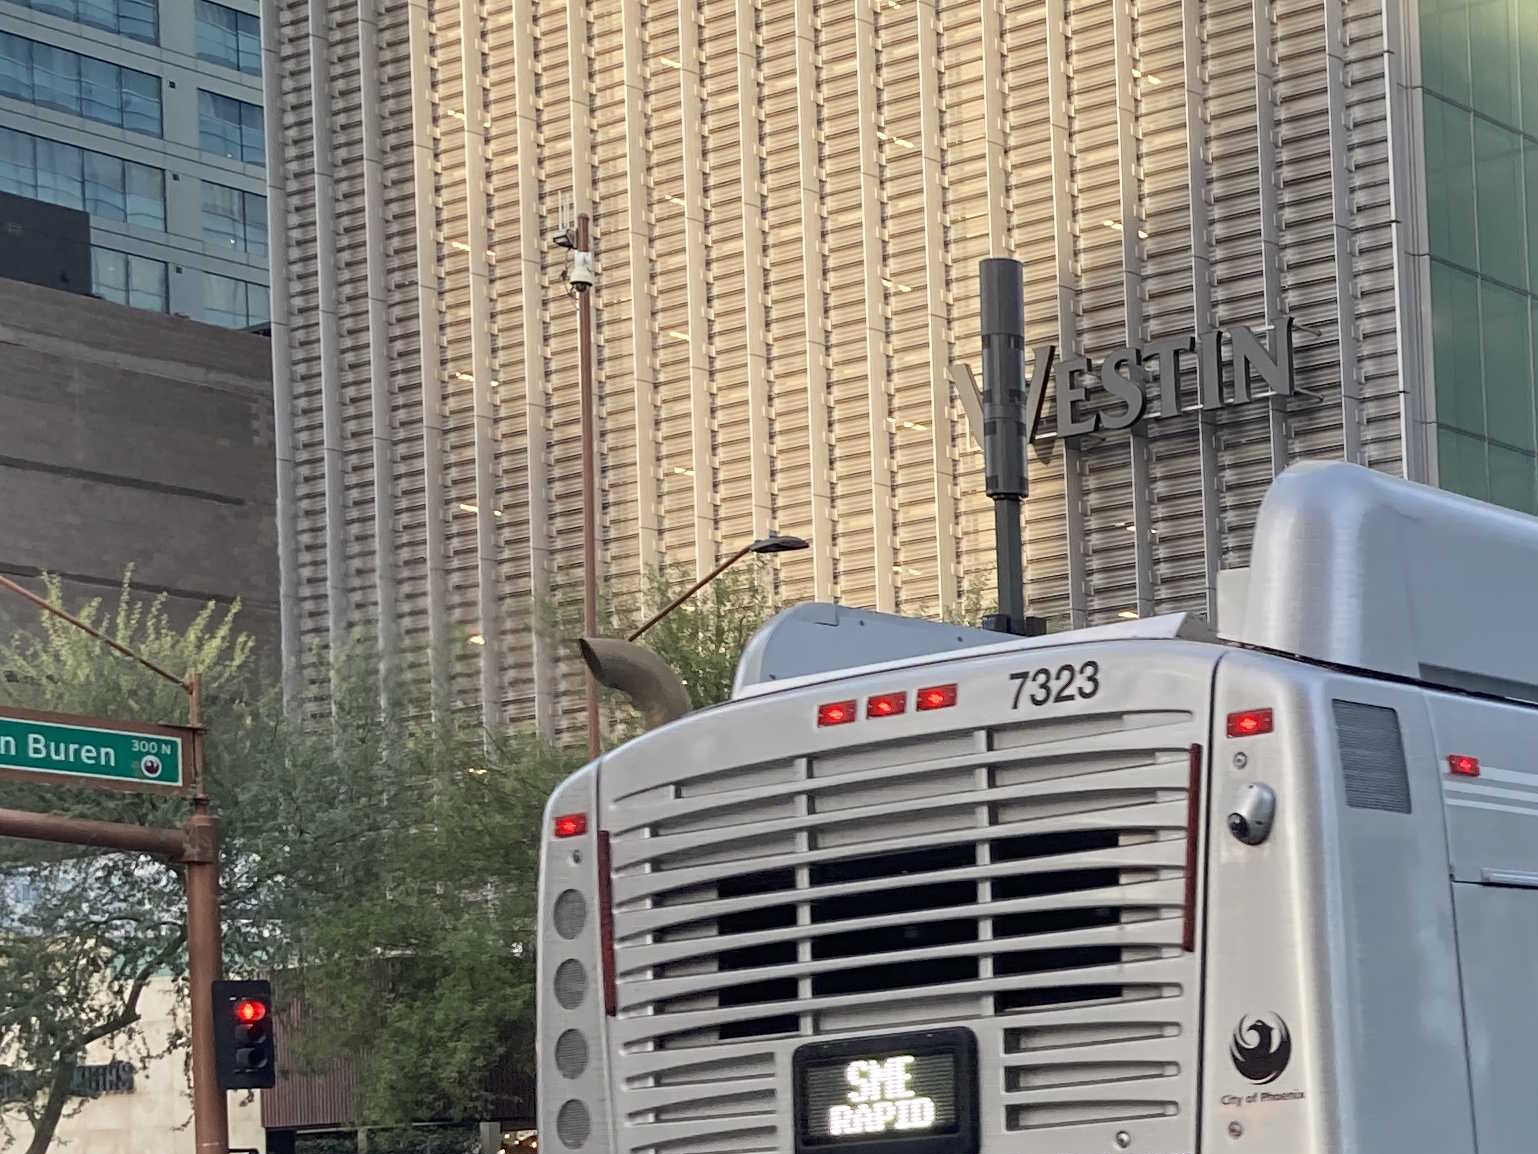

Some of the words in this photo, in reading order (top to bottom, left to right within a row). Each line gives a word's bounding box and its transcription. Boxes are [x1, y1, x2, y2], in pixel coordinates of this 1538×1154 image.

[950, 316, 1294, 449] WESTIN
[1010, 660, 1100, 710] 7323
[27, 733, 116, 767] Buren
[131, 739, 158, 754] 300
[161, 743, 172, 755] N
[828, 1096, 936, 1137] RAPID
